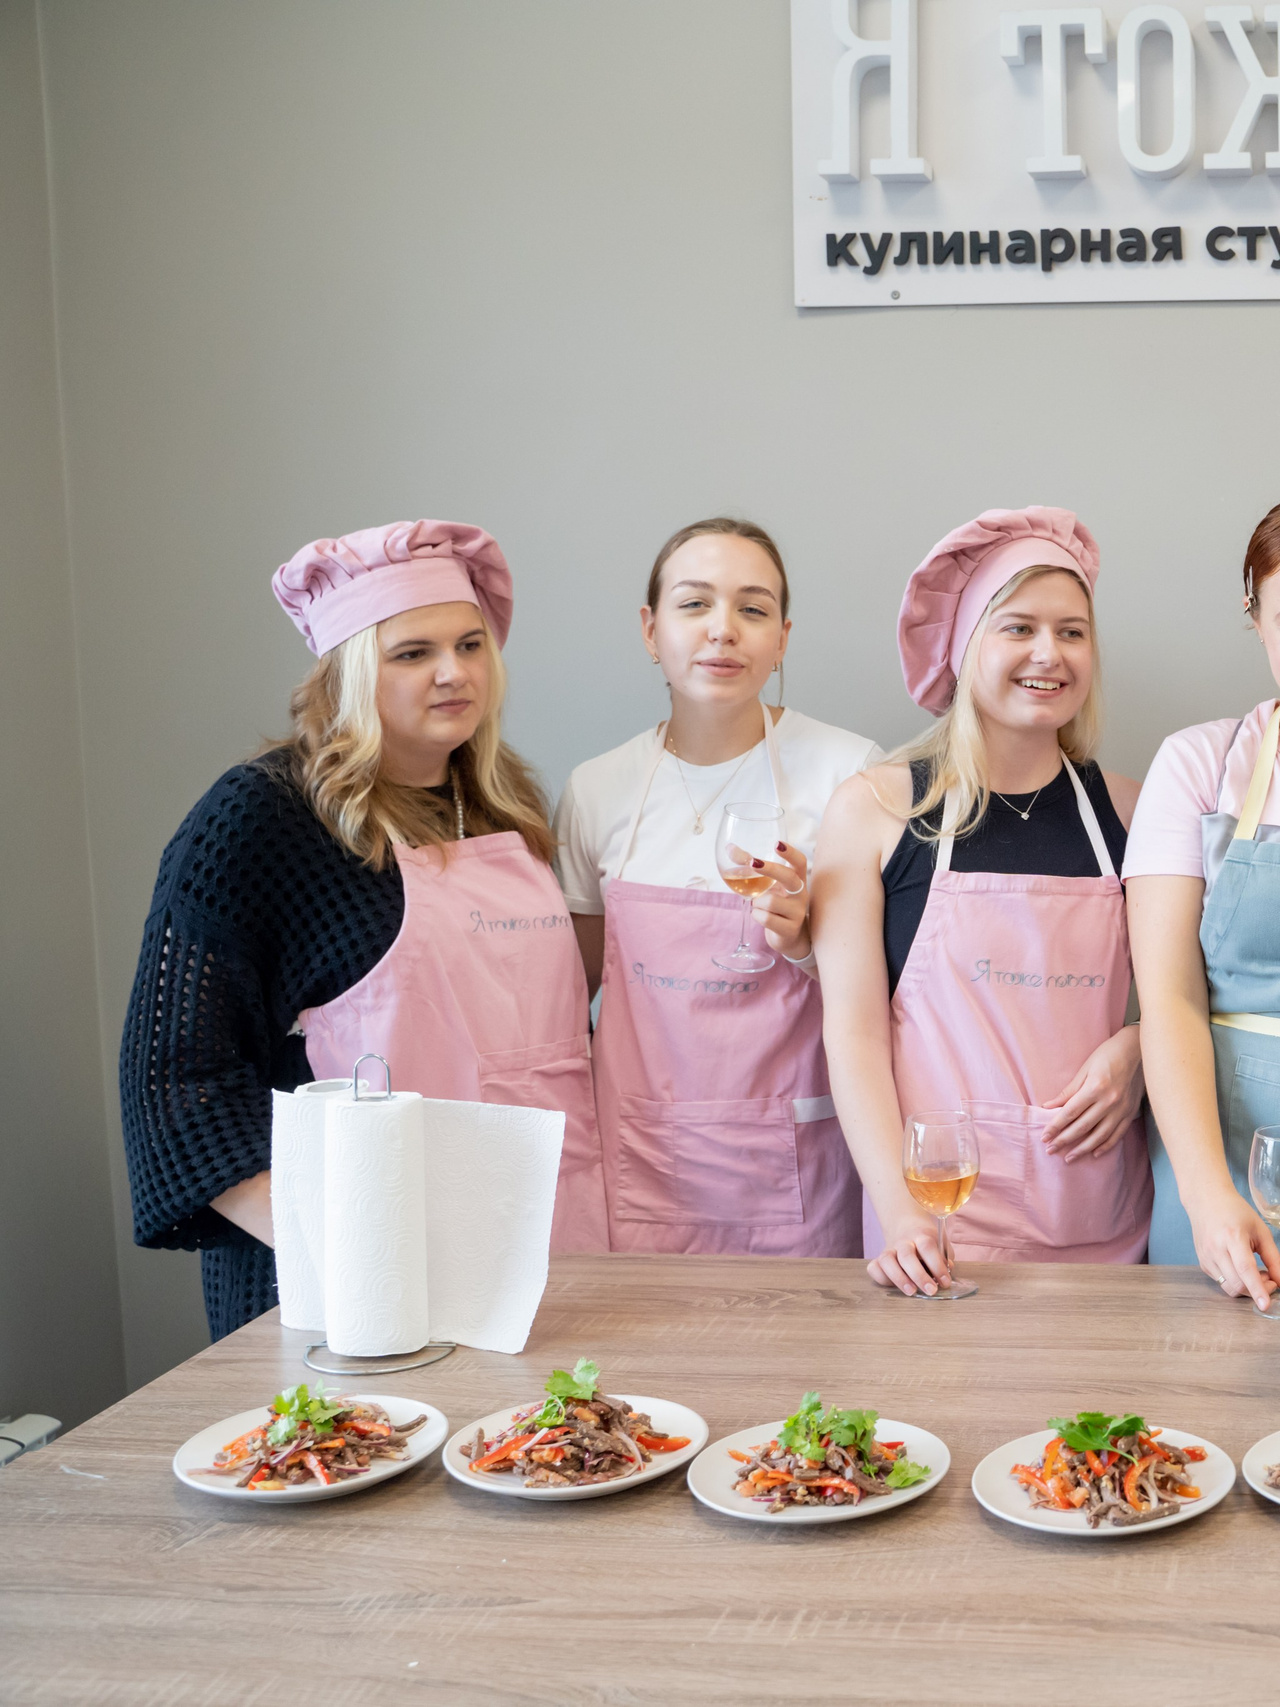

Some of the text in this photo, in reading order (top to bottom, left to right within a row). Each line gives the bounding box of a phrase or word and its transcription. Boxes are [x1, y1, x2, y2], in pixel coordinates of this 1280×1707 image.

[817, 0, 933, 183] Я
[824, 225, 1184, 276] кулинарная
[469, 910, 487, 934] Я
[628, 962, 646, 985] Я
[970, 958, 992, 984] Я
